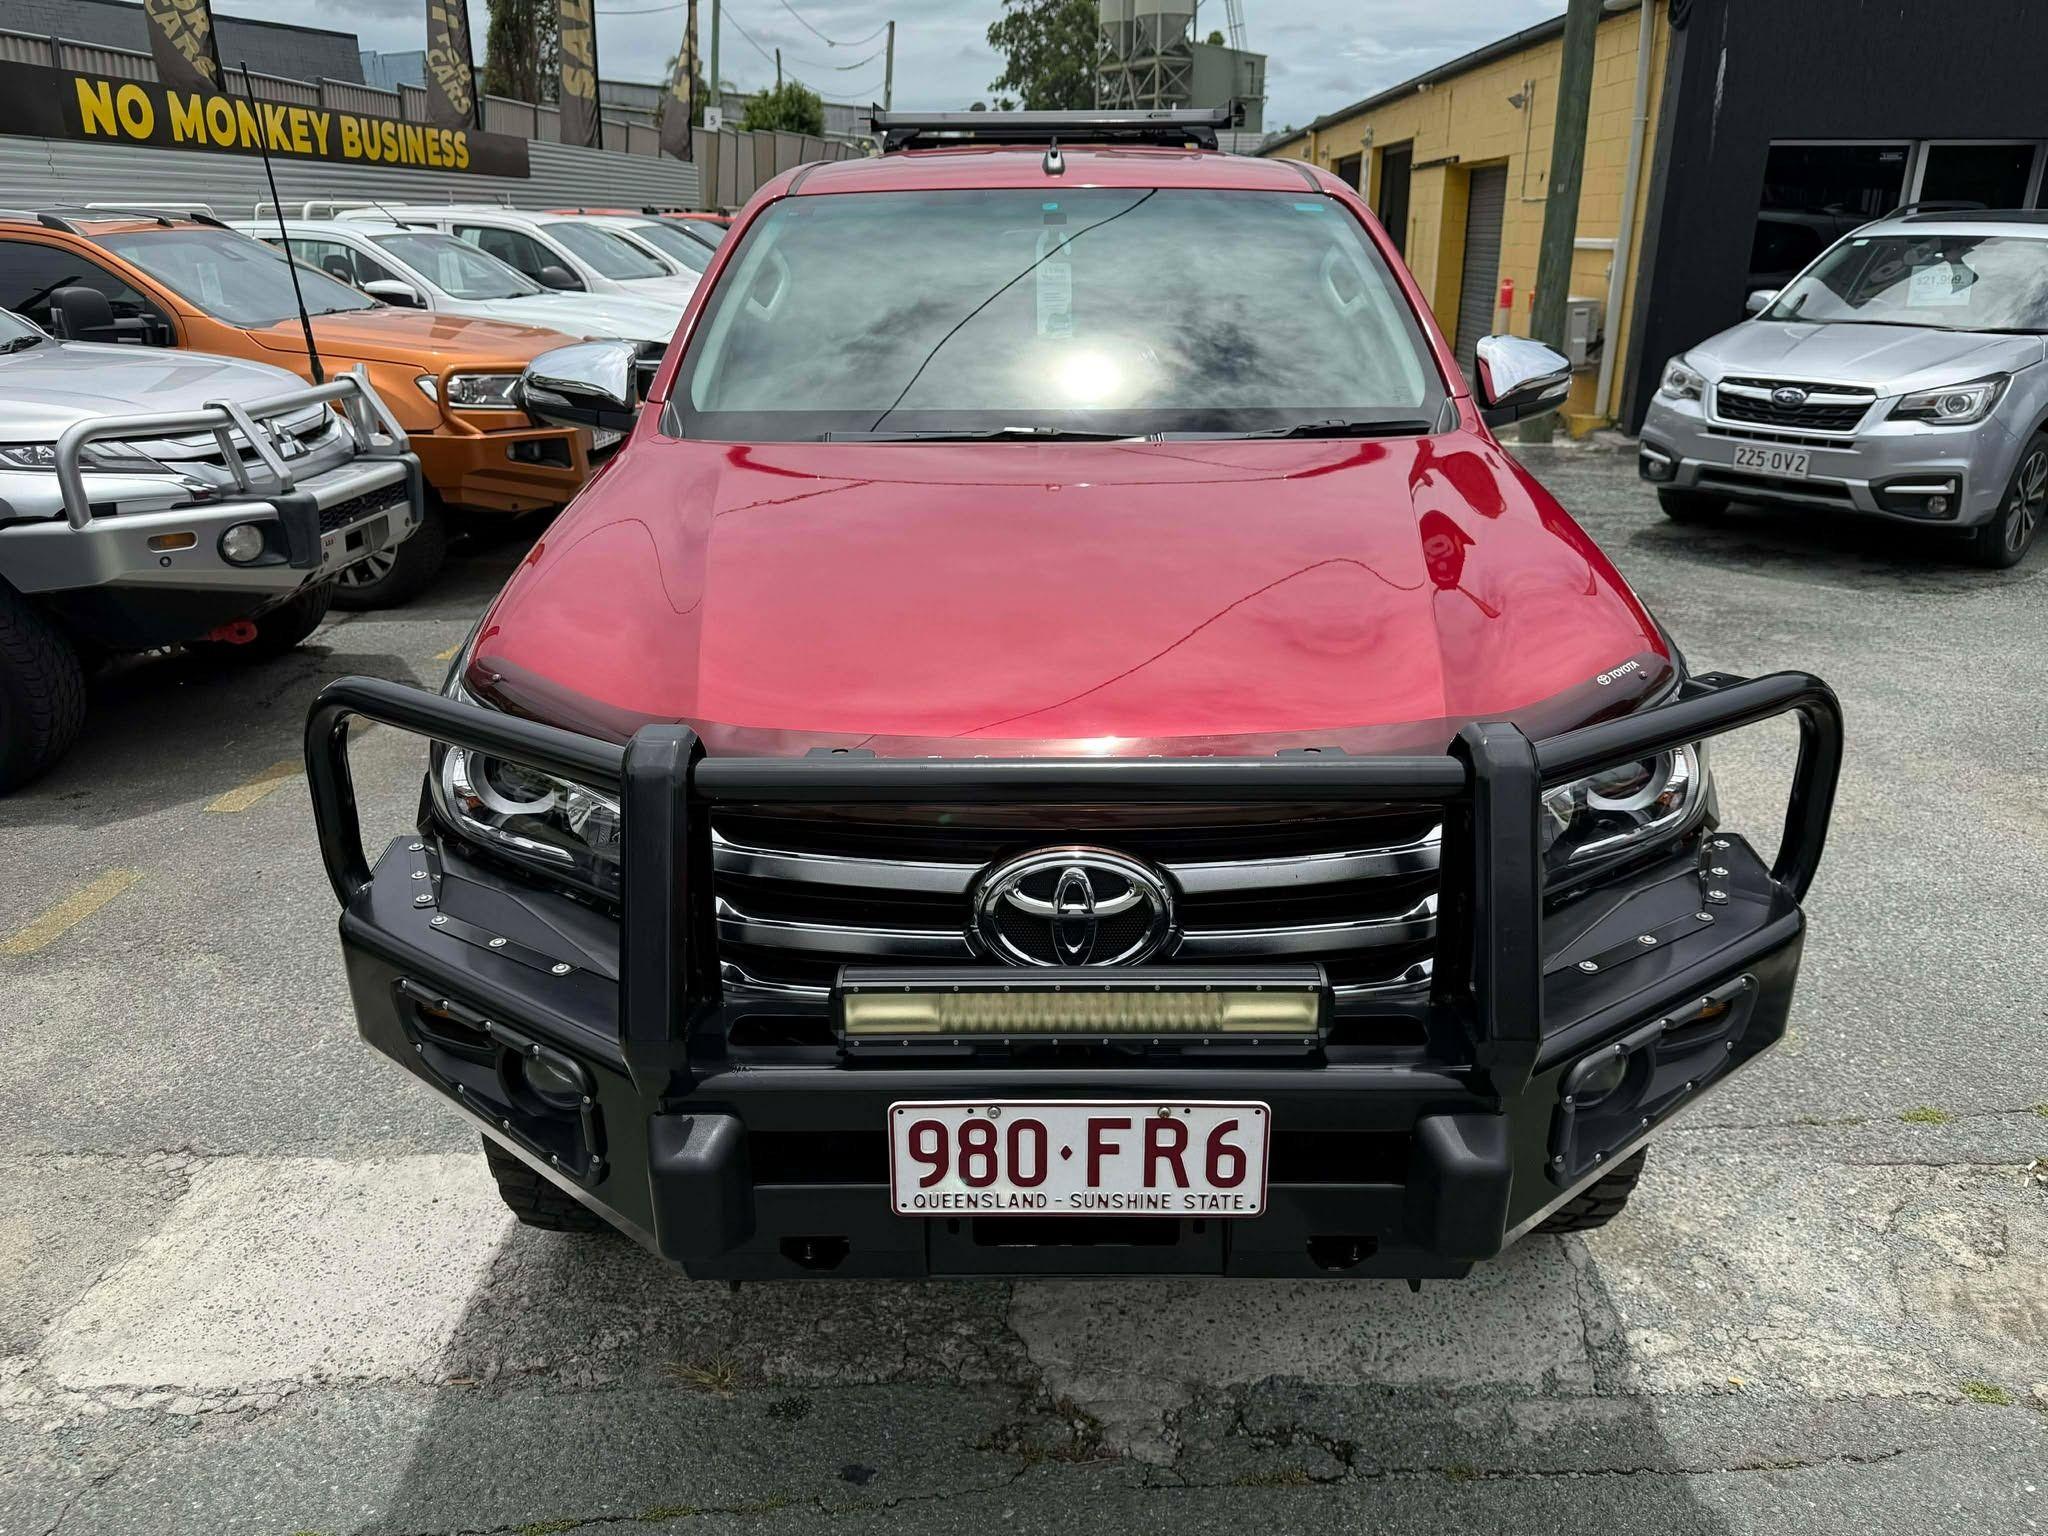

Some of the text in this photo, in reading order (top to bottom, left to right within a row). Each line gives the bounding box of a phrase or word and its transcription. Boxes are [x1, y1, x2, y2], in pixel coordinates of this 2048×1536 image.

[427, 48, 471, 115] CARS
[74, 77, 470, 170] NO MONKEY BUSINESS
[1608, 660, 1641, 680] TOYOTA
[913, 1193, 1048, 1210] QUEENSLAND
[1070, 1193, 1172, 1210] SUNSHINE
[1184, 1193, 1244, 1210] STATE
